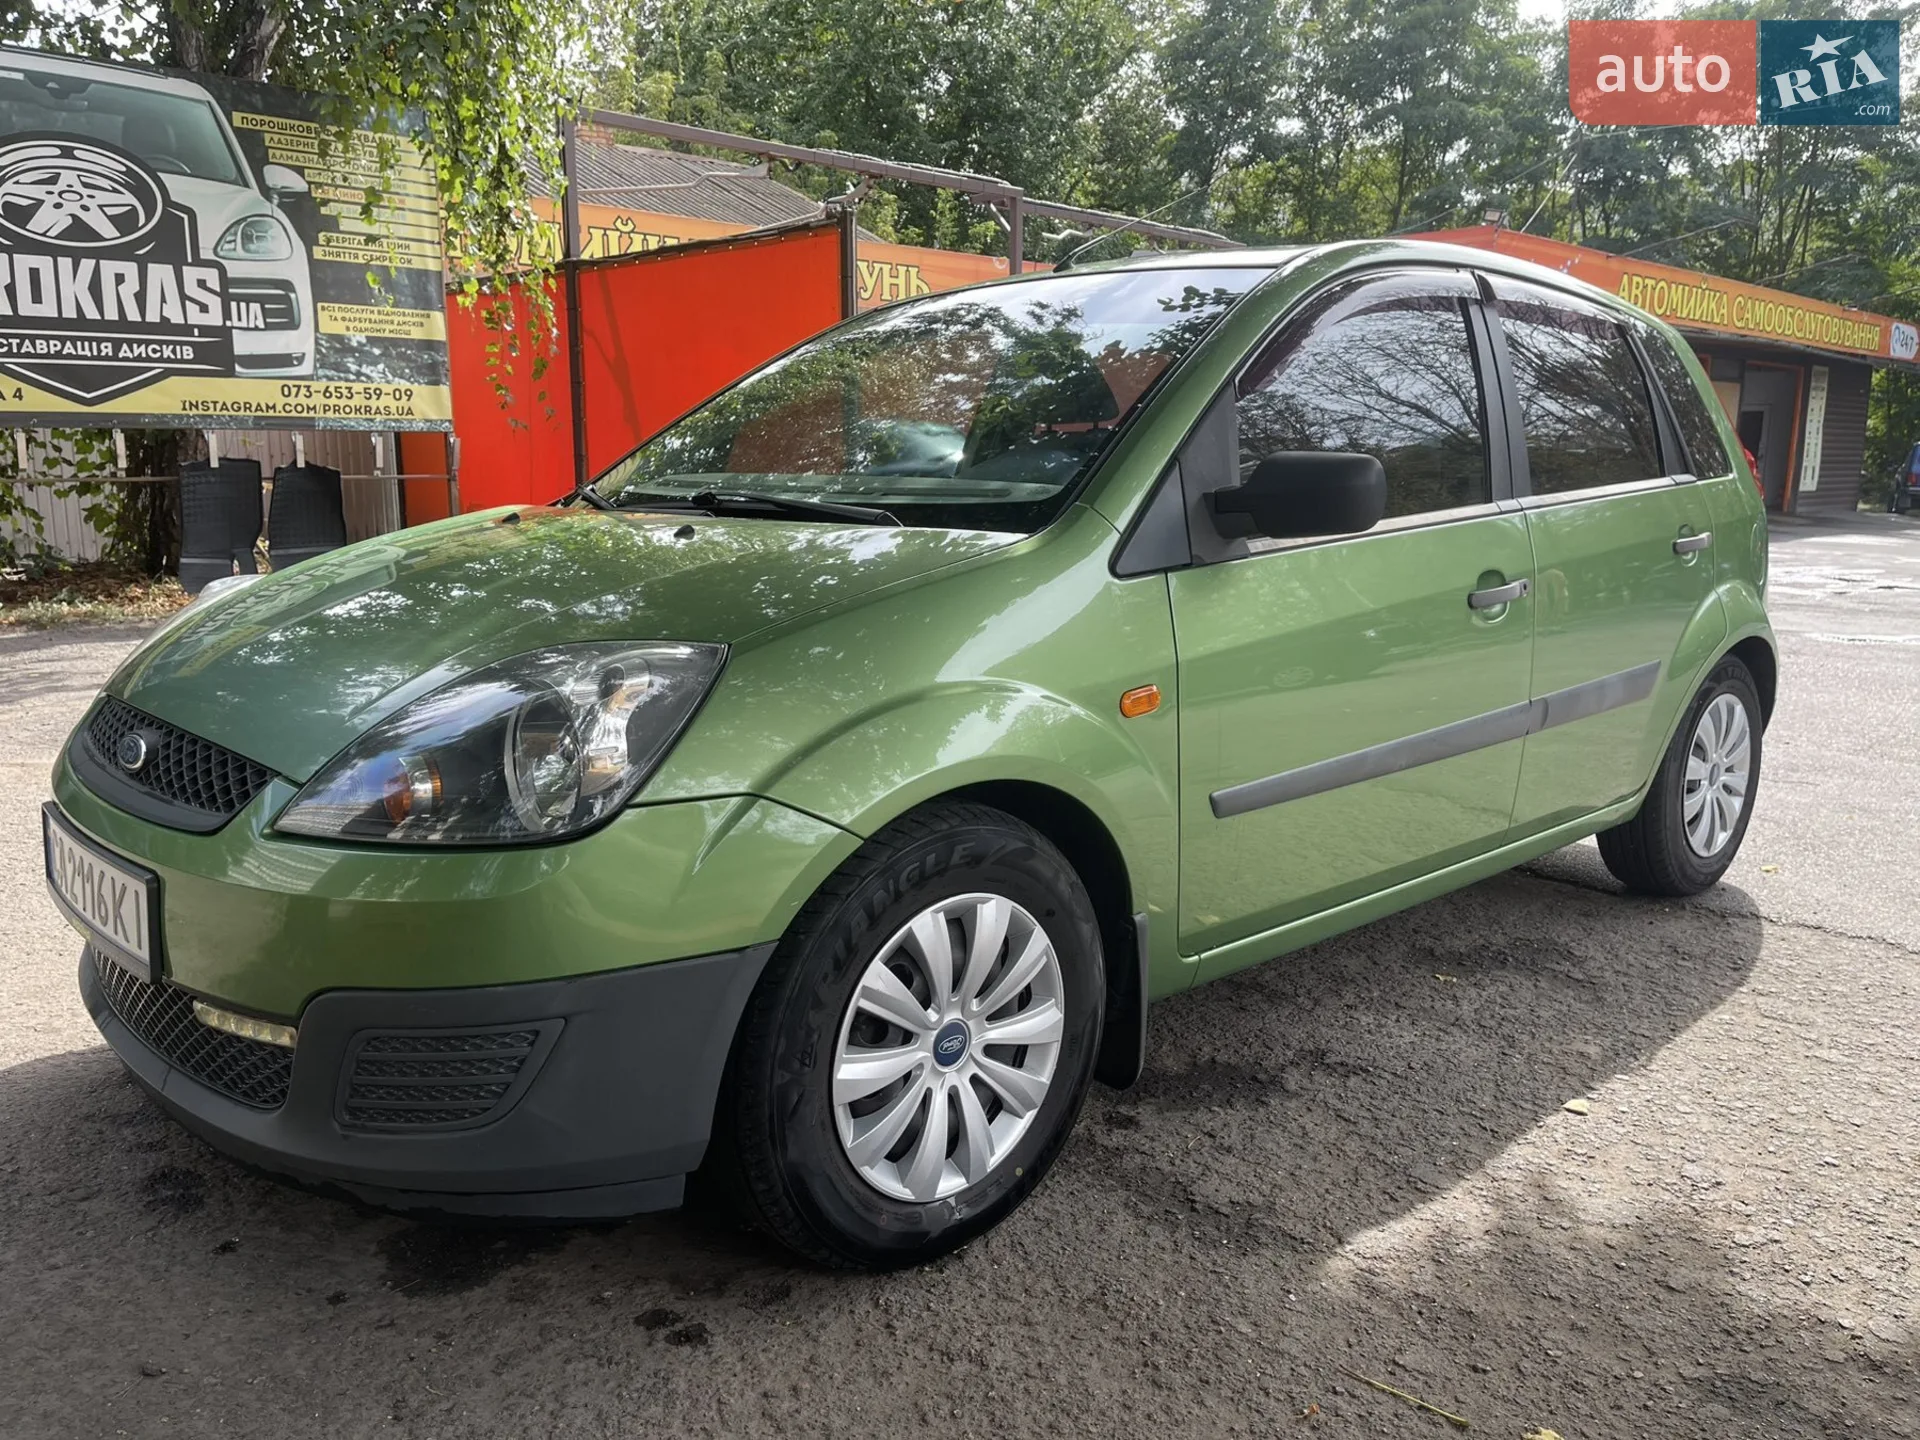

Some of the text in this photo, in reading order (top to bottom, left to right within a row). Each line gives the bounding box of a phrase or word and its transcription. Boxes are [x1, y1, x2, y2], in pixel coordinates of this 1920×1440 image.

[268, 136, 316, 150] ЛАЗЕРНЕ
[321, 249, 359, 260] ЗНЯТТЯ
[1617, 272, 1881, 351] АВТОМИЙКА САМООБСЛУГОВУВАННЯ
[118, 342, 195, 359] ДИСКІВ
[12, 387, 24, 401] 4
[281, 384, 414, 402] 073-653-59-09
[180, 399, 415, 417] INSTAGRAM.COM/PROKRAS.UA
